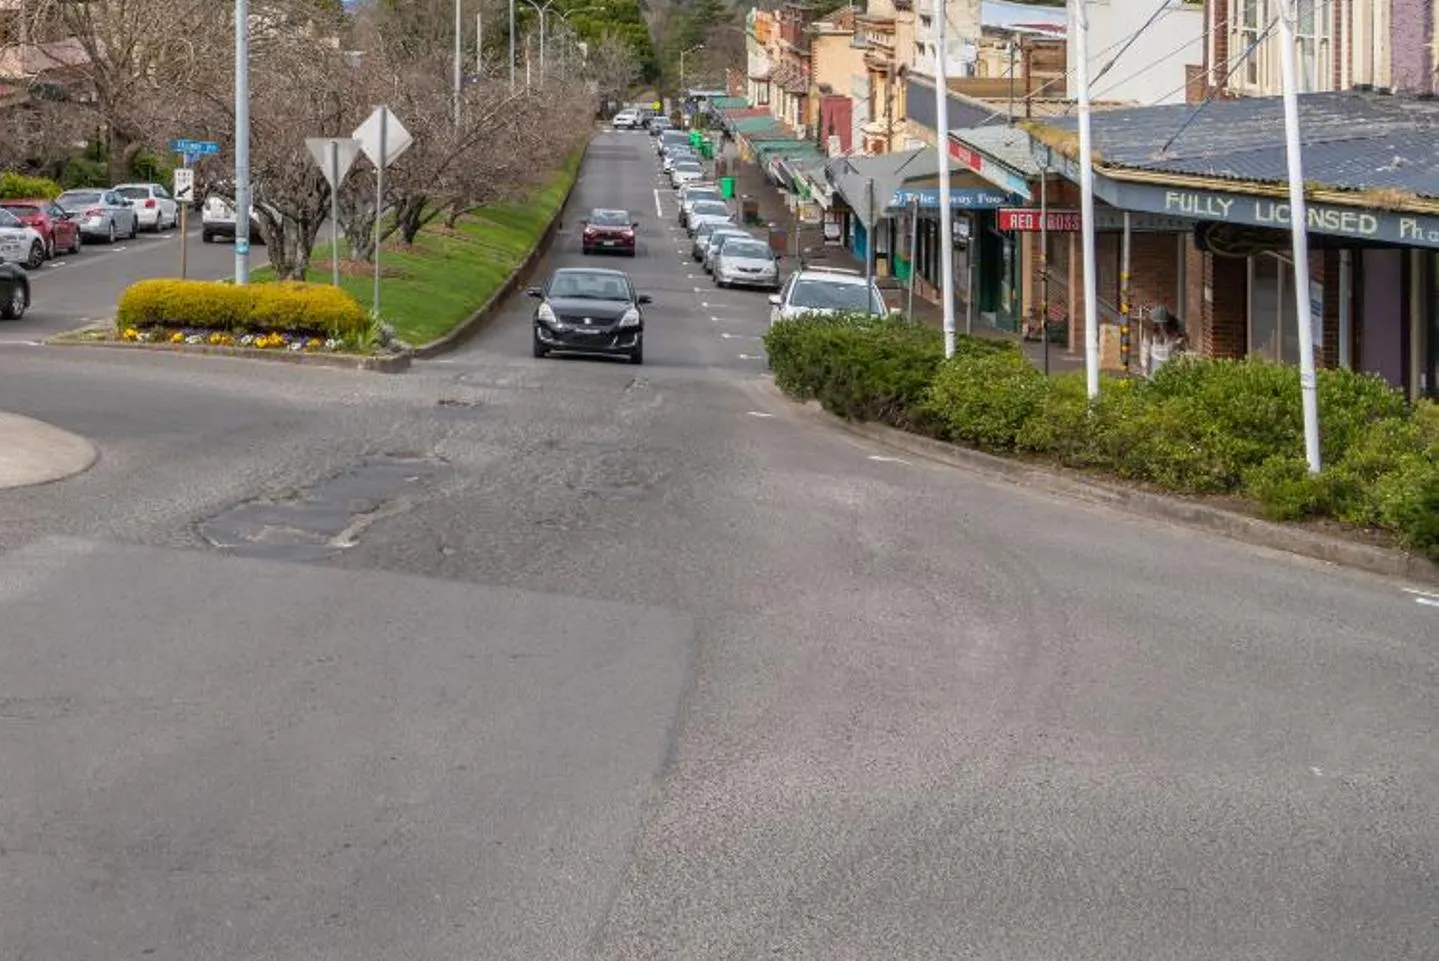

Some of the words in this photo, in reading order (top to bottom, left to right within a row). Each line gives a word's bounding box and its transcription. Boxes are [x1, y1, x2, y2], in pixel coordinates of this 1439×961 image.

[1010, 214, 1033, 229] RED
[1164, 191, 1234, 217] FULLY
[1255, 200, 1378, 234] LICNSED
